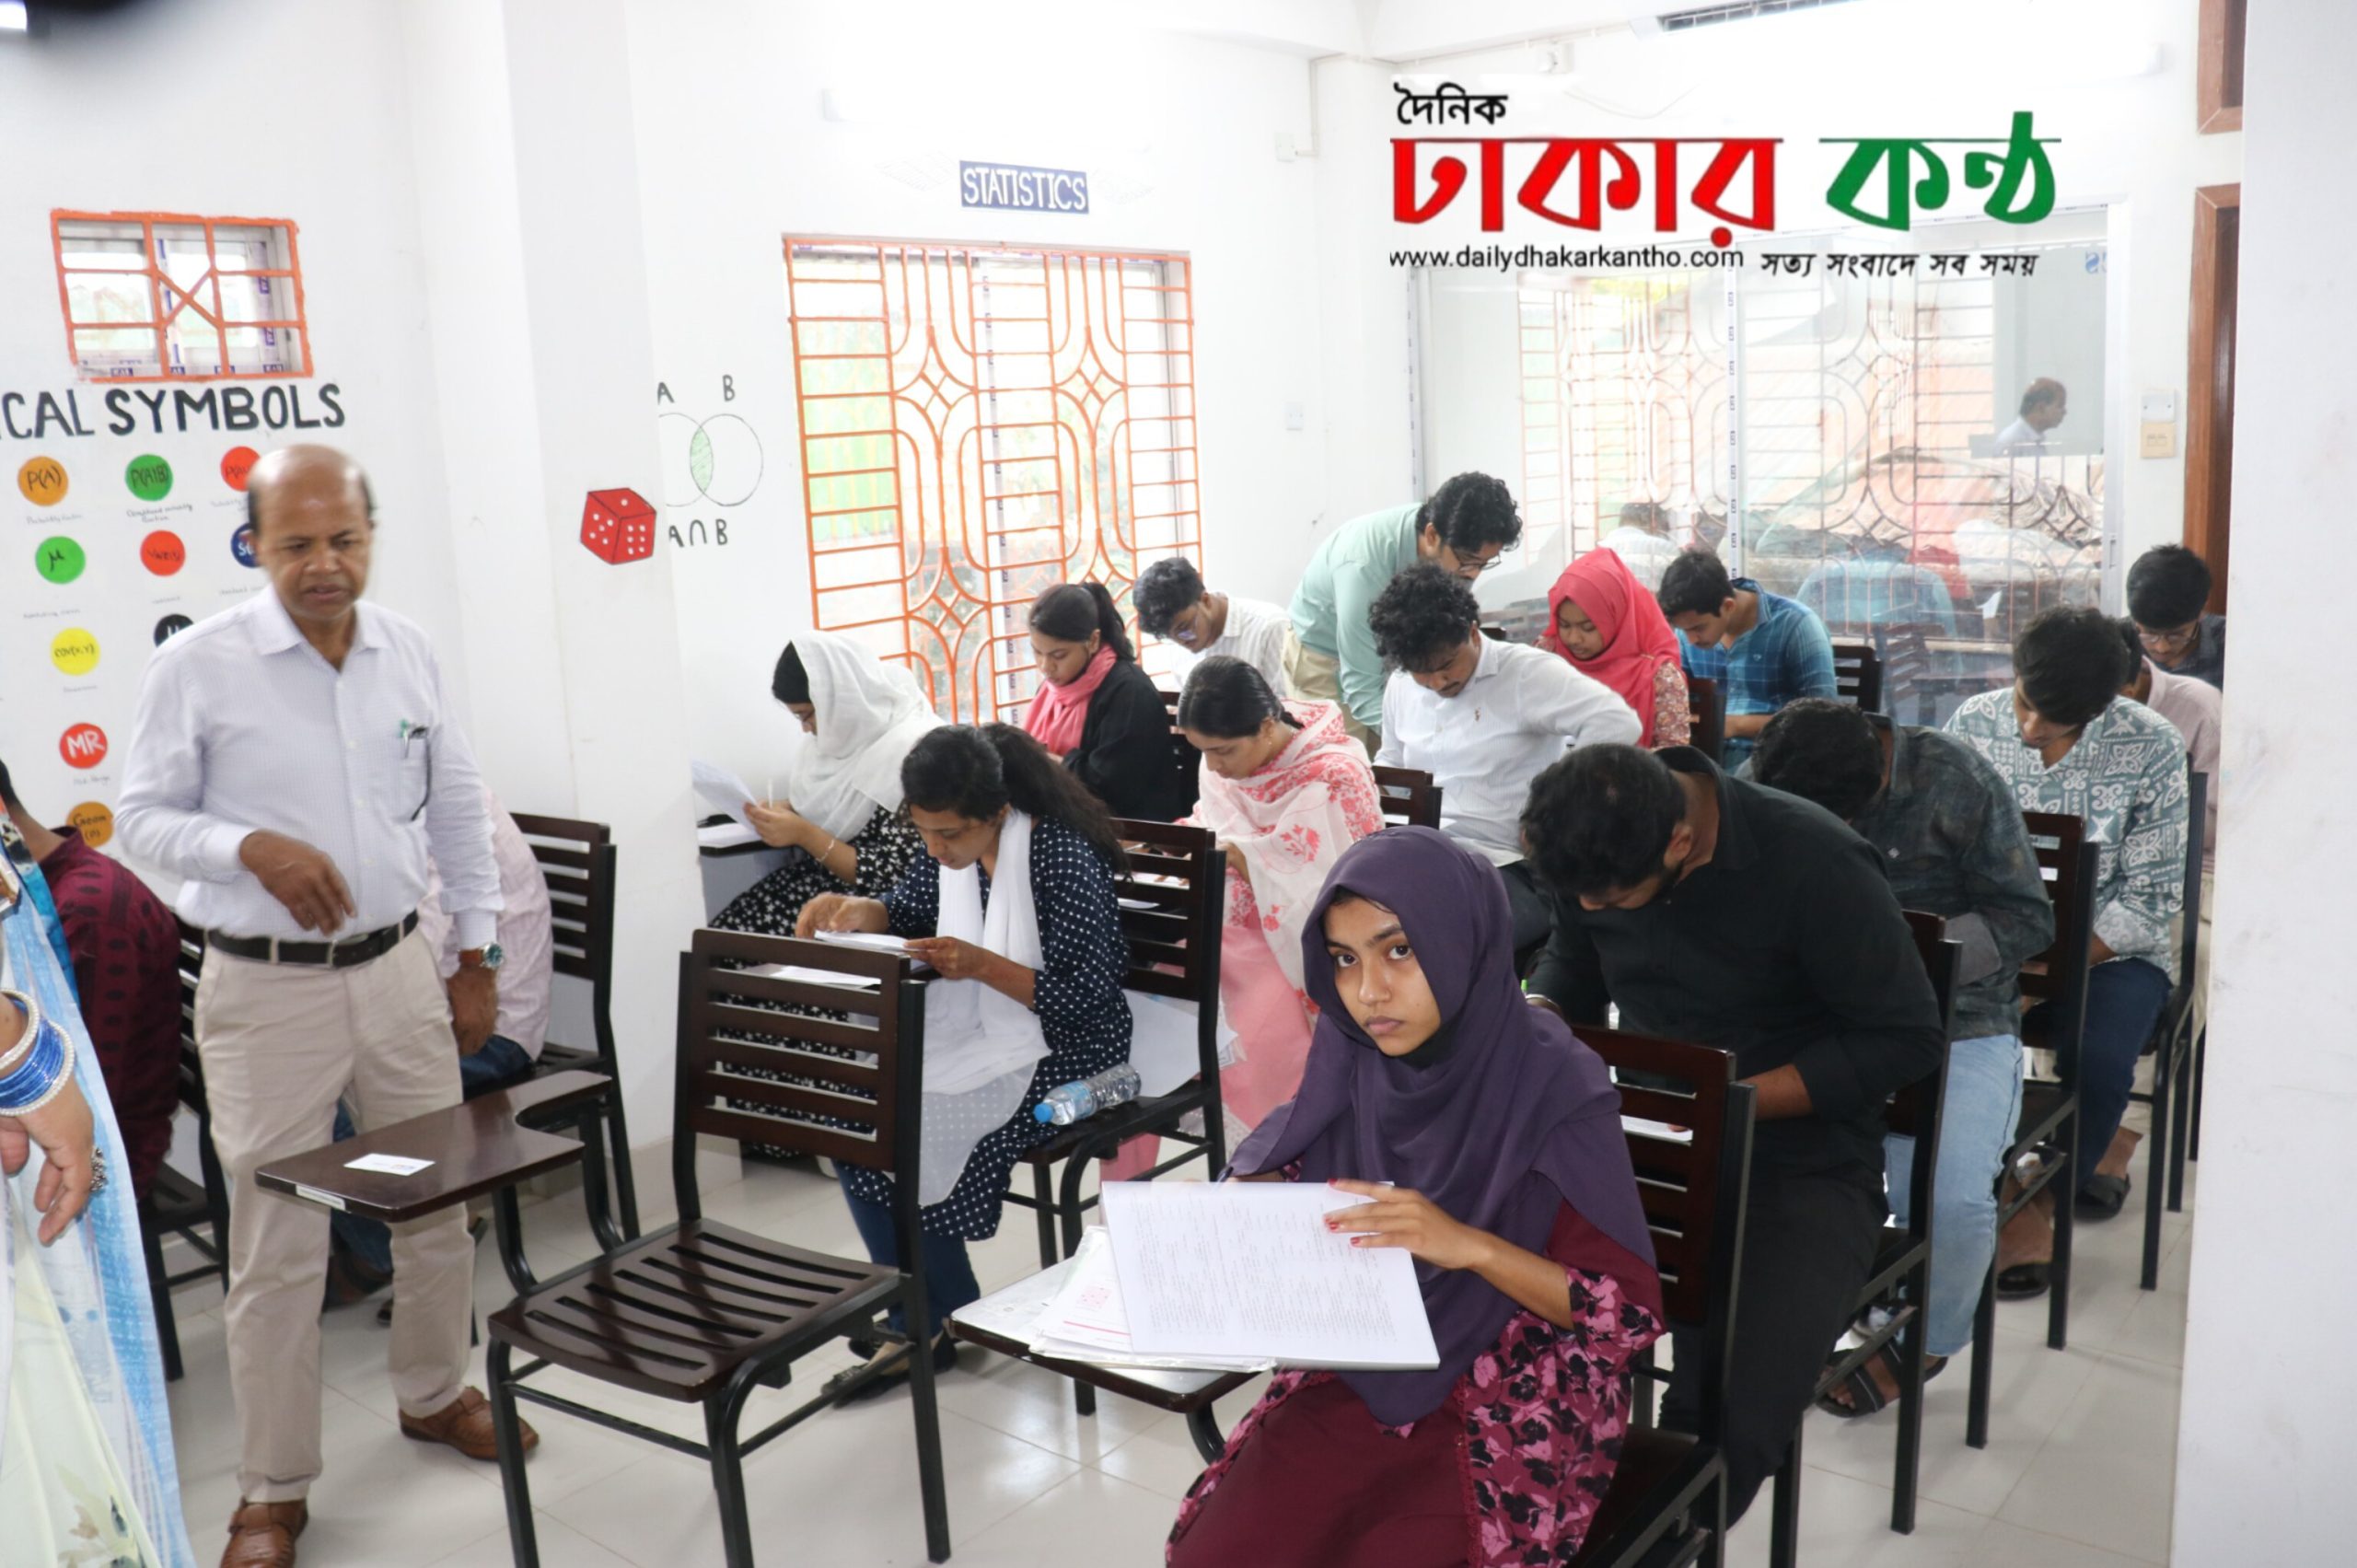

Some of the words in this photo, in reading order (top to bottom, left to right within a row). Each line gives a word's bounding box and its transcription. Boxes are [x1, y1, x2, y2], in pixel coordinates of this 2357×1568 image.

[962, 168, 1086, 210] STATISTICS
[657, 382, 675, 405] A
[723, 374, 736, 401] B
[0, 389, 95, 439] CAL
[105, 383, 346, 436] SYMBOLS
[66, 729, 105, 759] MR
